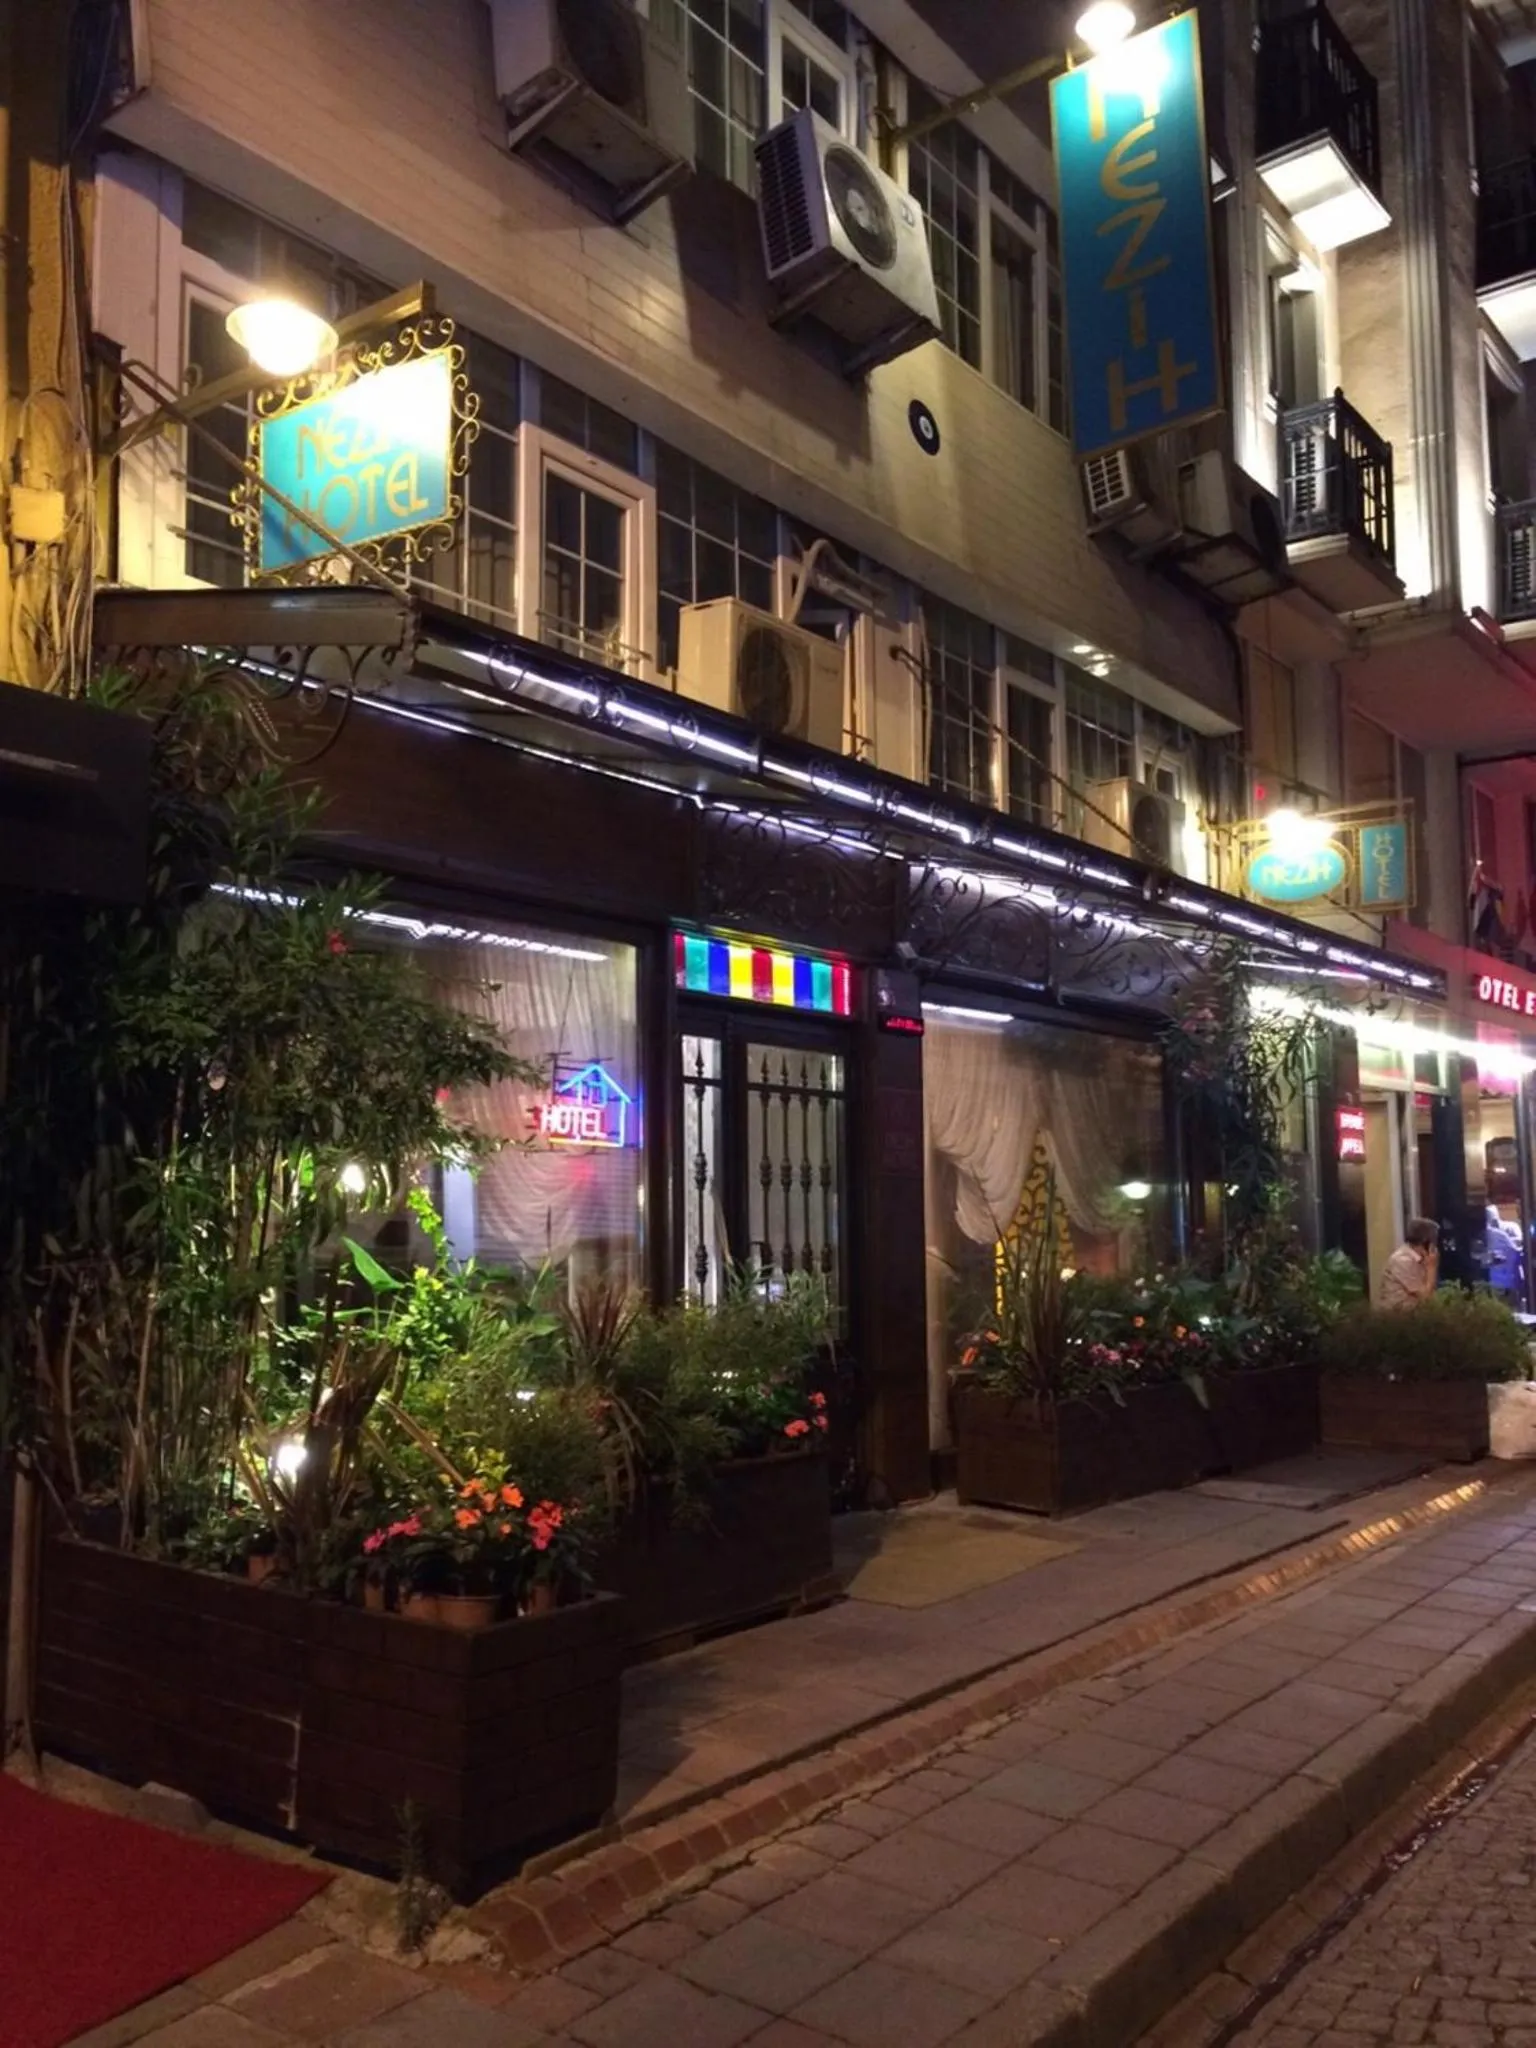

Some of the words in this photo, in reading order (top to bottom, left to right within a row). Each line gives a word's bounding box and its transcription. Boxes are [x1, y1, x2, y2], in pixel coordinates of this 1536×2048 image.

[283, 453, 429, 548] HOTEL
[1479, 975, 1520, 1011] OTEL
[541, 1103, 607, 1140] HOTEL
